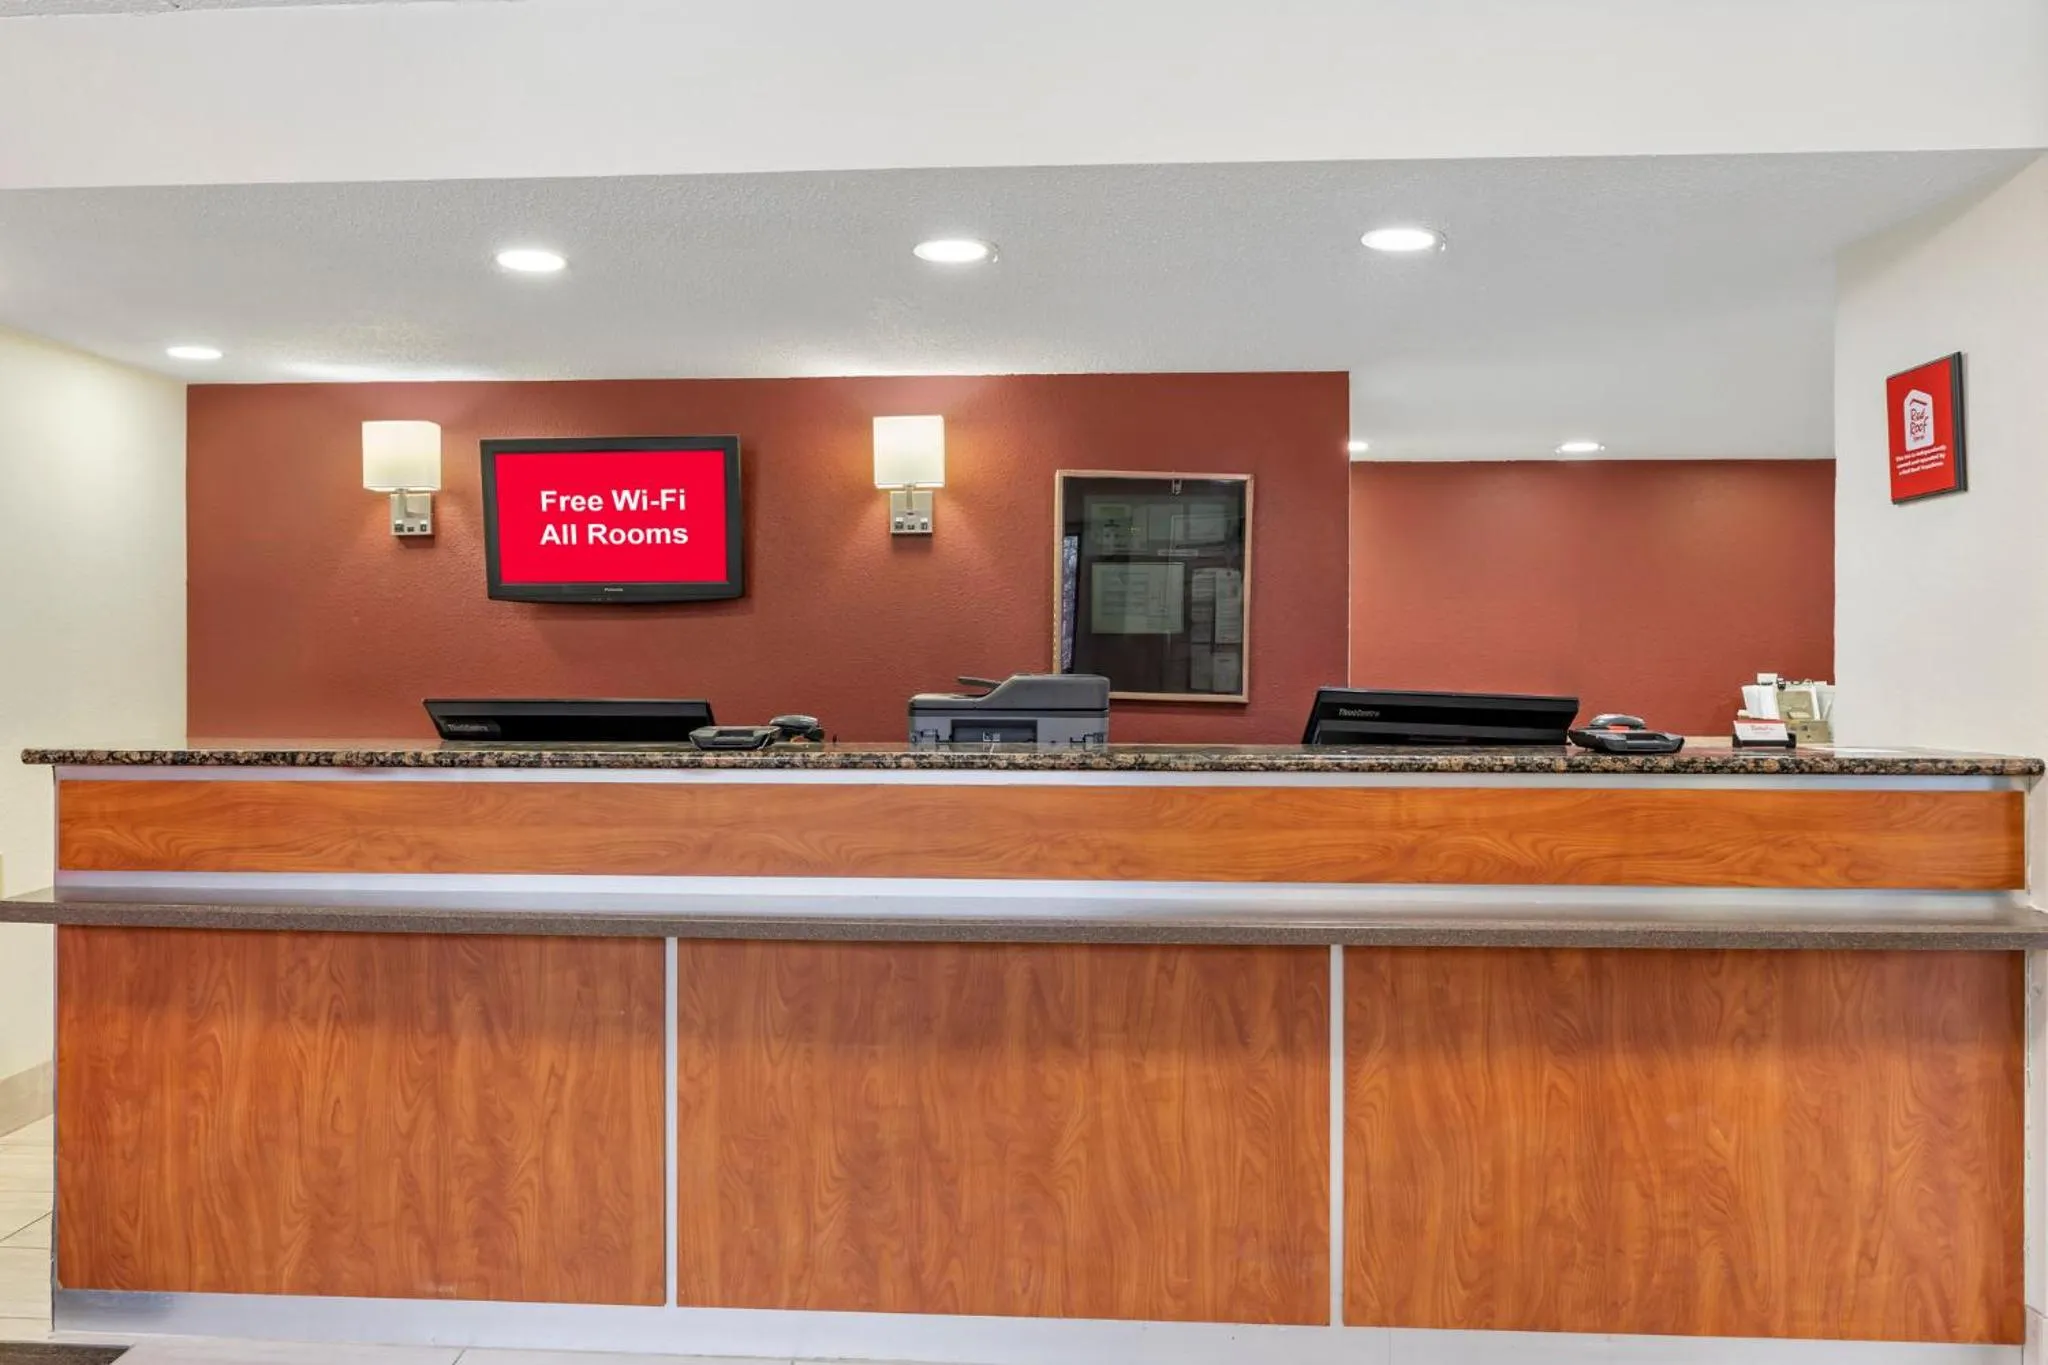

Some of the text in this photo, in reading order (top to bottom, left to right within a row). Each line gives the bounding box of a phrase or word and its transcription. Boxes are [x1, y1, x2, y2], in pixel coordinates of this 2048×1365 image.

[1911, 408, 1925, 420] Red
[540, 489, 686, 512] Free Wi-Fi
[540, 523, 689, 545] All Rooms
